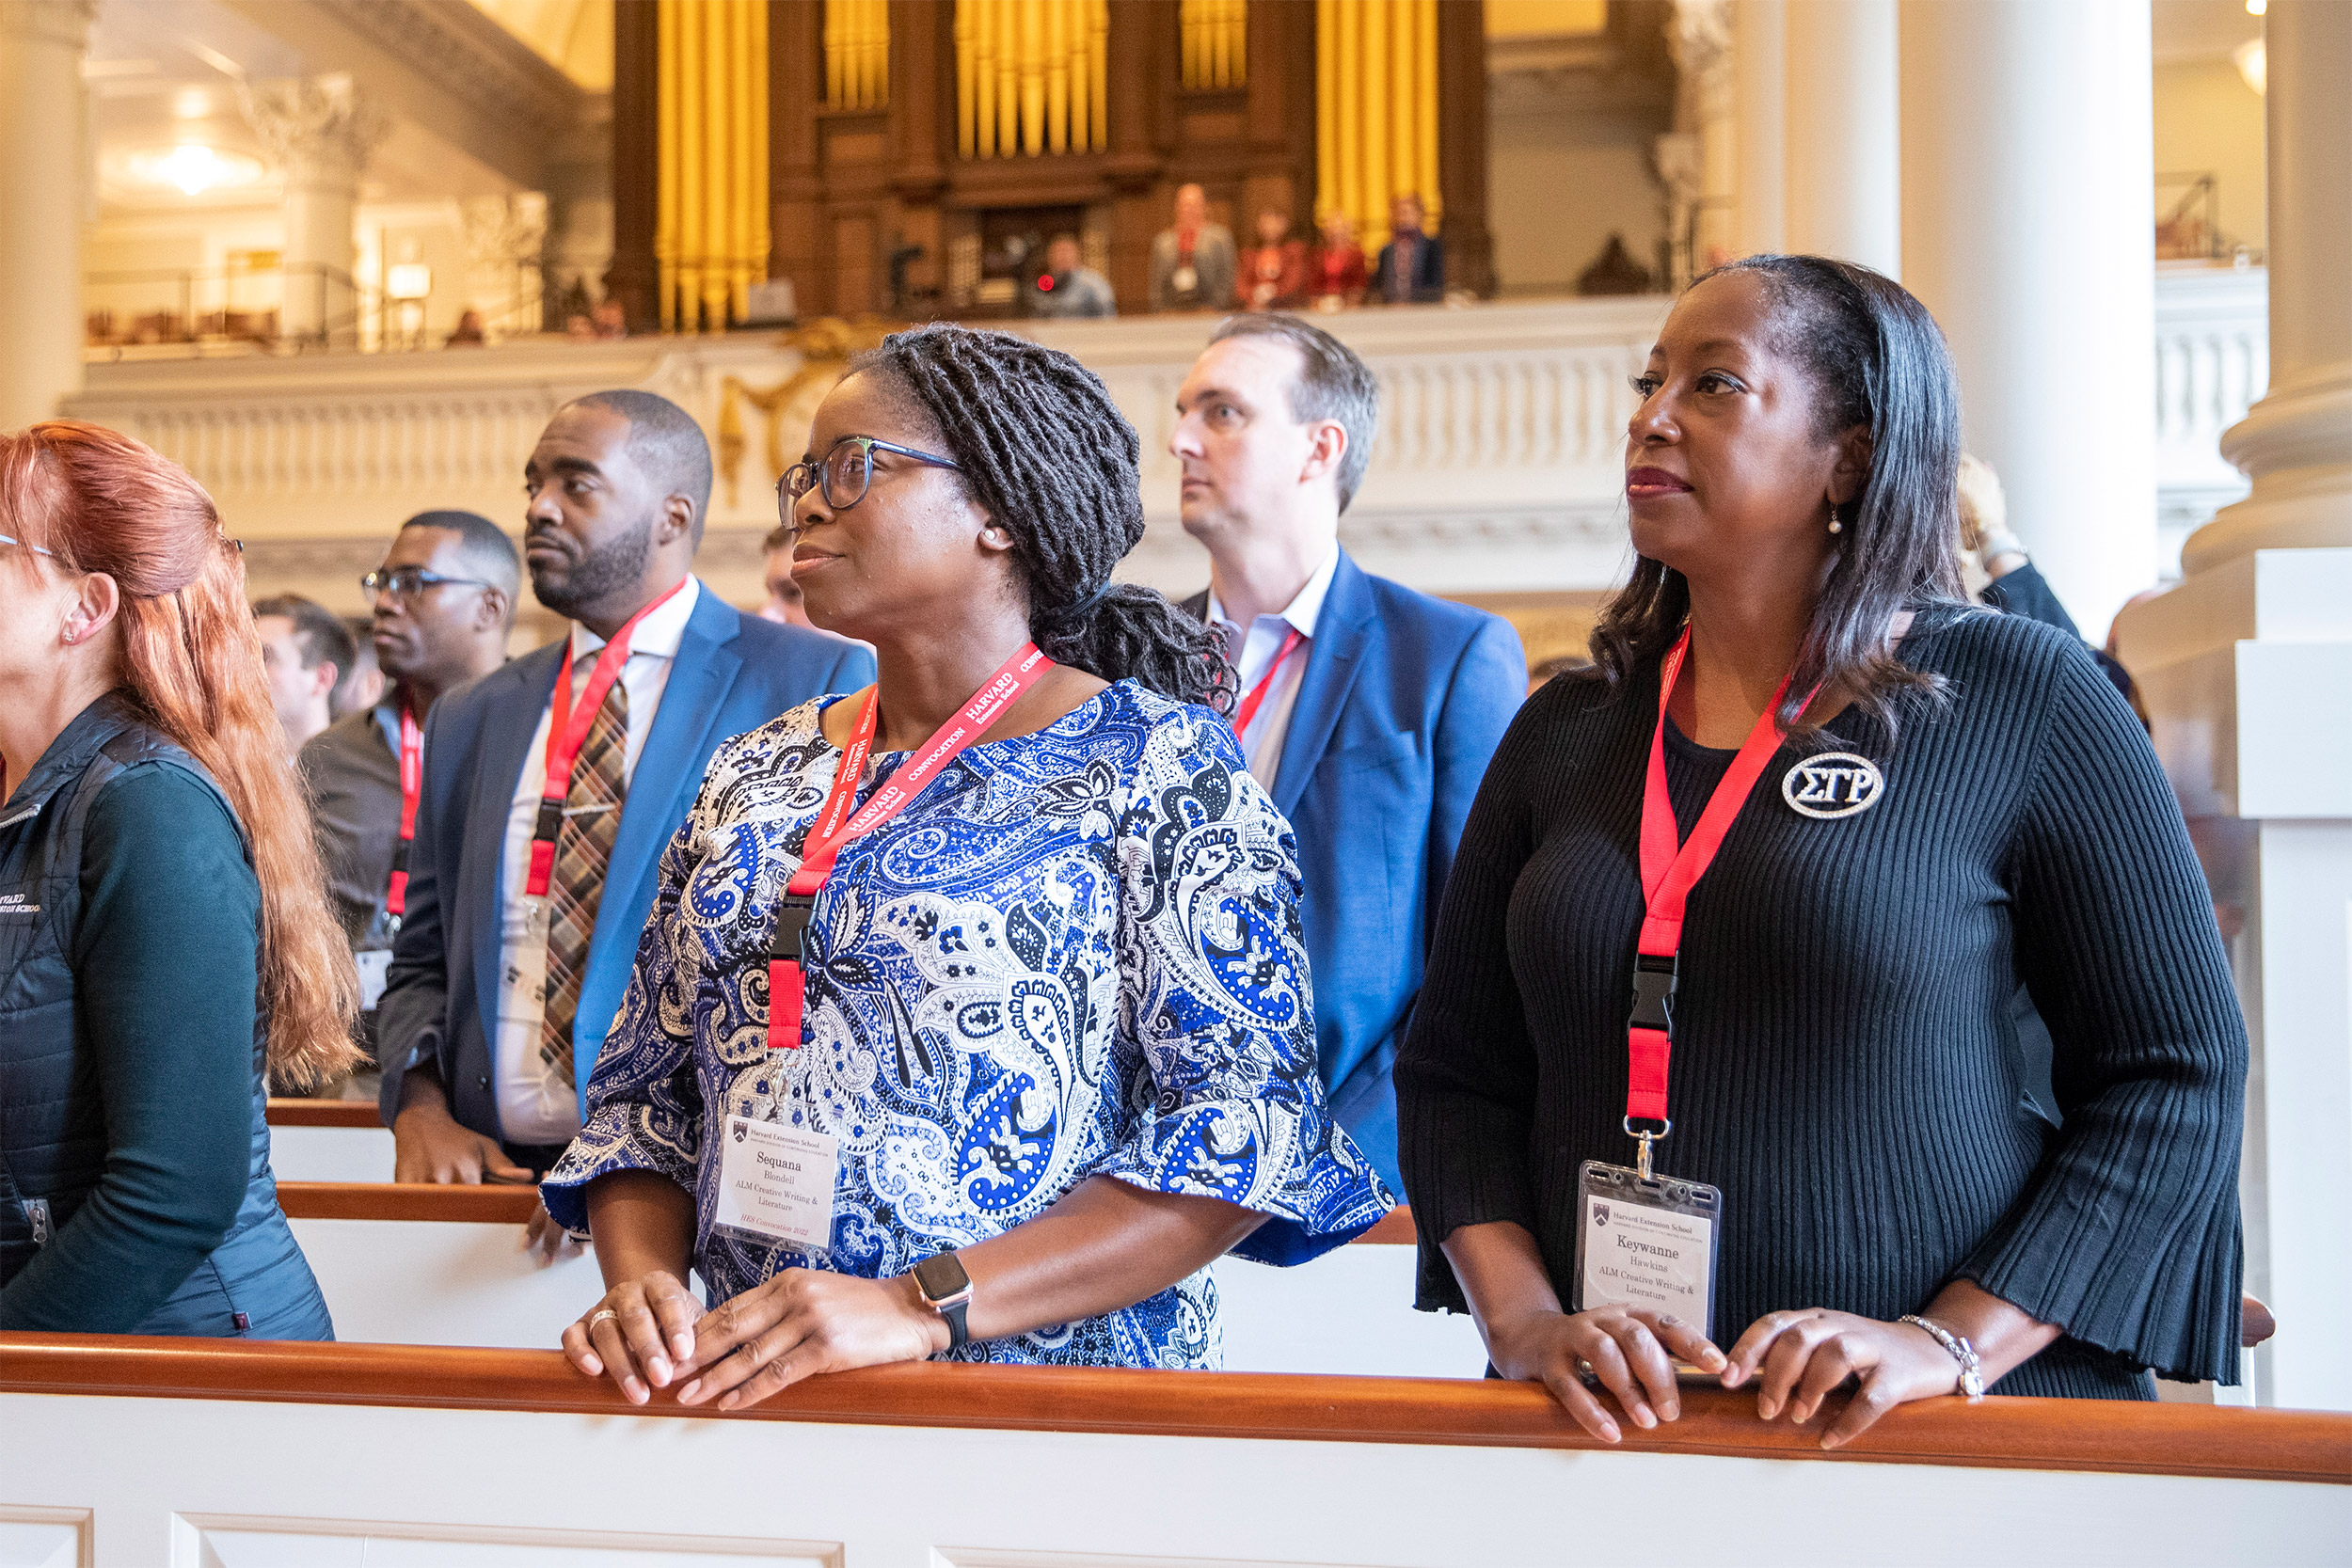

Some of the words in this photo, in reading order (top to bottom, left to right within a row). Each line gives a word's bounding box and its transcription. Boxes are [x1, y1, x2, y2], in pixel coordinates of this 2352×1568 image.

[965, 673, 1013, 721] HARVARD
[975, 699, 1004, 725] Extension
[1000, 680, 1020, 700] School
[847, 738, 867, 782] HARVARD
[908, 726, 965, 781] CONVOCATION
[849, 786, 898, 832] HARVARD
[885, 791, 907, 810] School
[821, 790, 847, 837] CONVOCATION
[751, 1129, 771, 1138] Harvard
[773, 1134, 800, 1145] Extension
[801, 1139, 820, 1148] School
[756, 1151, 802, 1172] Sequana
[764, 1170, 795, 1185] Blondell
[736, 1180, 753, 1191] ALM
[755, 1183, 783, 1196] Creative
[784, 1190, 810, 1205] Writing
[811, 1196, 818, 1206] &
[758, 1196, 792, 1212] Literature
[740, 1213, 756, 1223] HES
[756, 1217, 792, 1232] Convocation
[793, 1227, 809, 1236] 2022
[1613, 1212, 1638, 1223] Harvard
[1640, 1217, 1669, 1229] Extension
[1671, 1225, 1692, 1234] School
[1616, 1234, 1678, 1259] Keywanne
[1630, 1256, 1668, 1273] Hawkins
[1599, 1266, 1619, 1277] ALM
[1620, 1271, 1654, 1286] Creative
[1655, 1278, 1686, 1294] Writing
[1687, 1285, 1693, 1294] &
[1626, 1285, 1665, 1301] Literature
